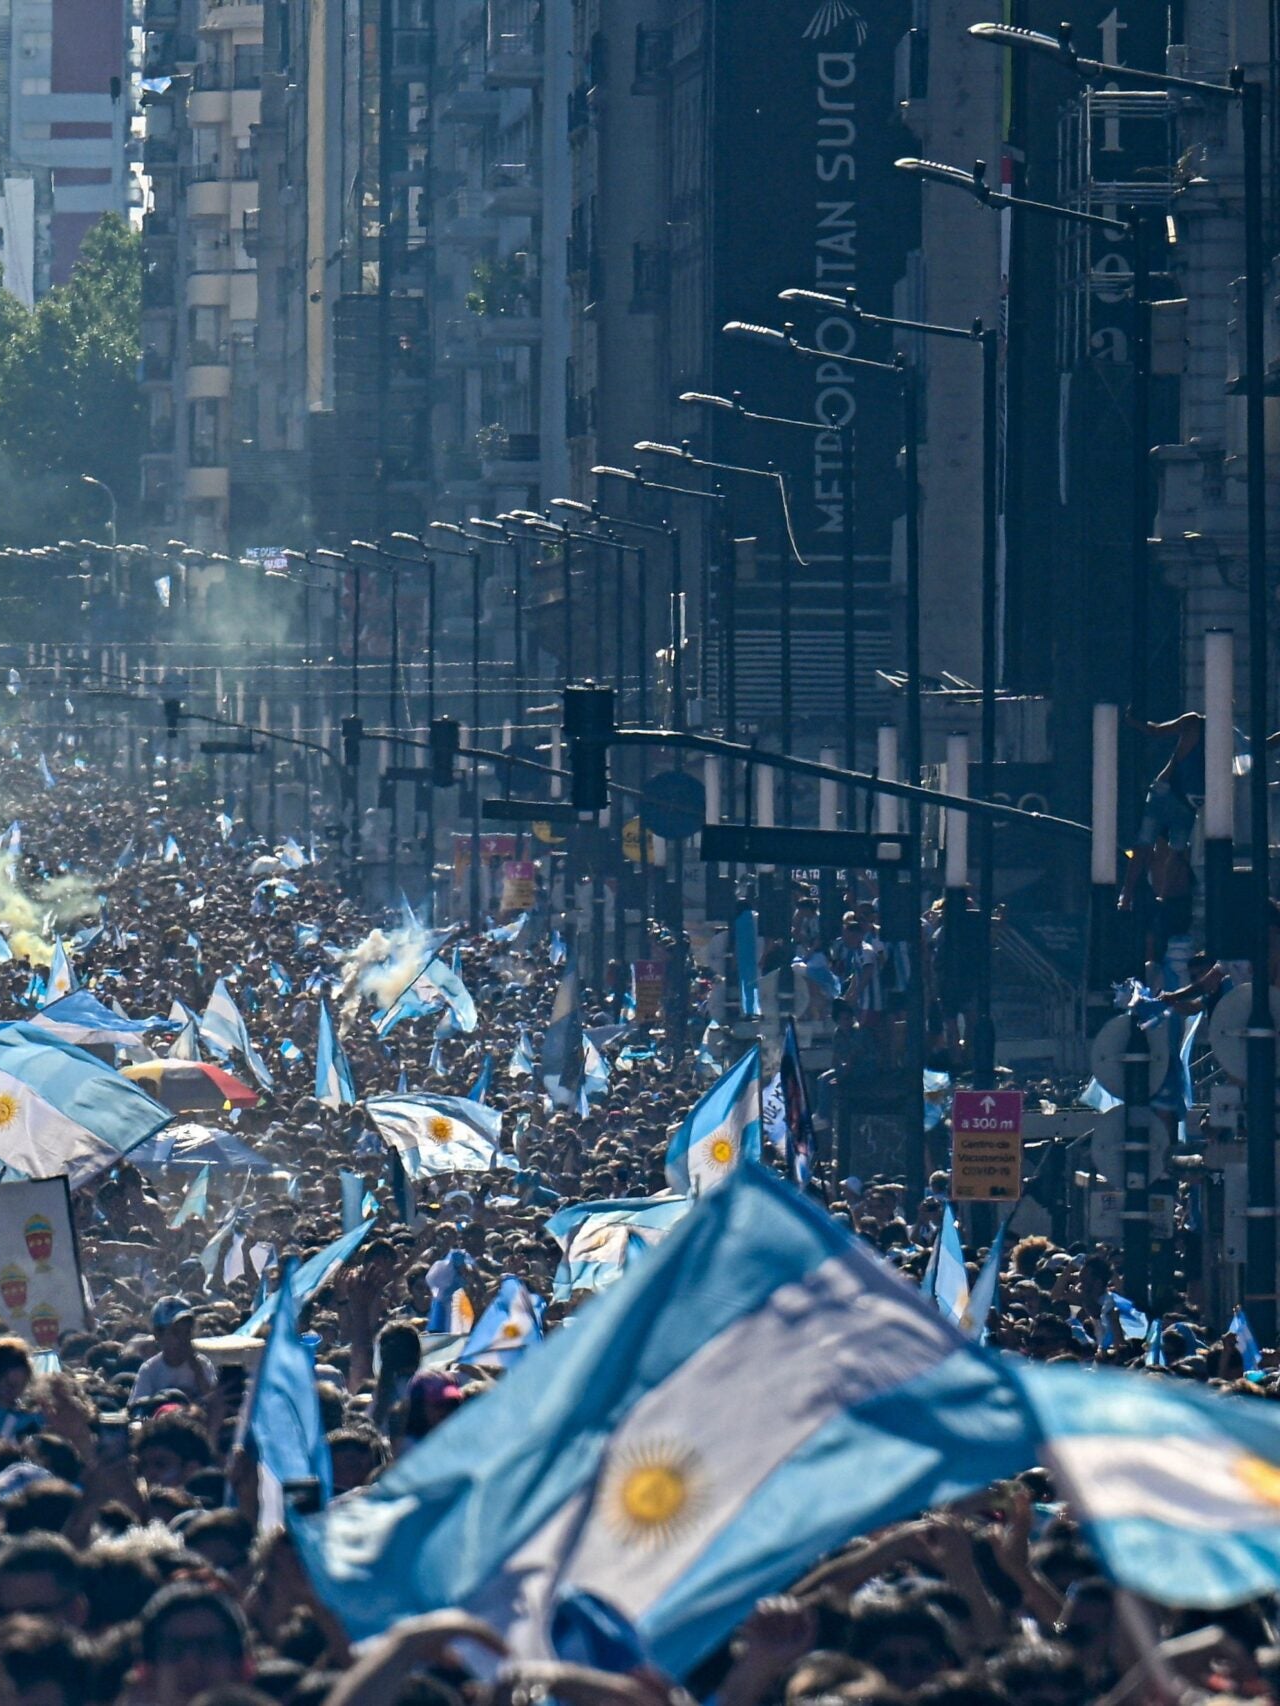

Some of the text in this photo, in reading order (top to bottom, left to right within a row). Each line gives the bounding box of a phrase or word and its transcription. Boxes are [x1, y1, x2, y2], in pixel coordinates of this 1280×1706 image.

[815, 202, 856, 534] METROPOITAN
[962, 1118, 1013, 1129] a 300 m
